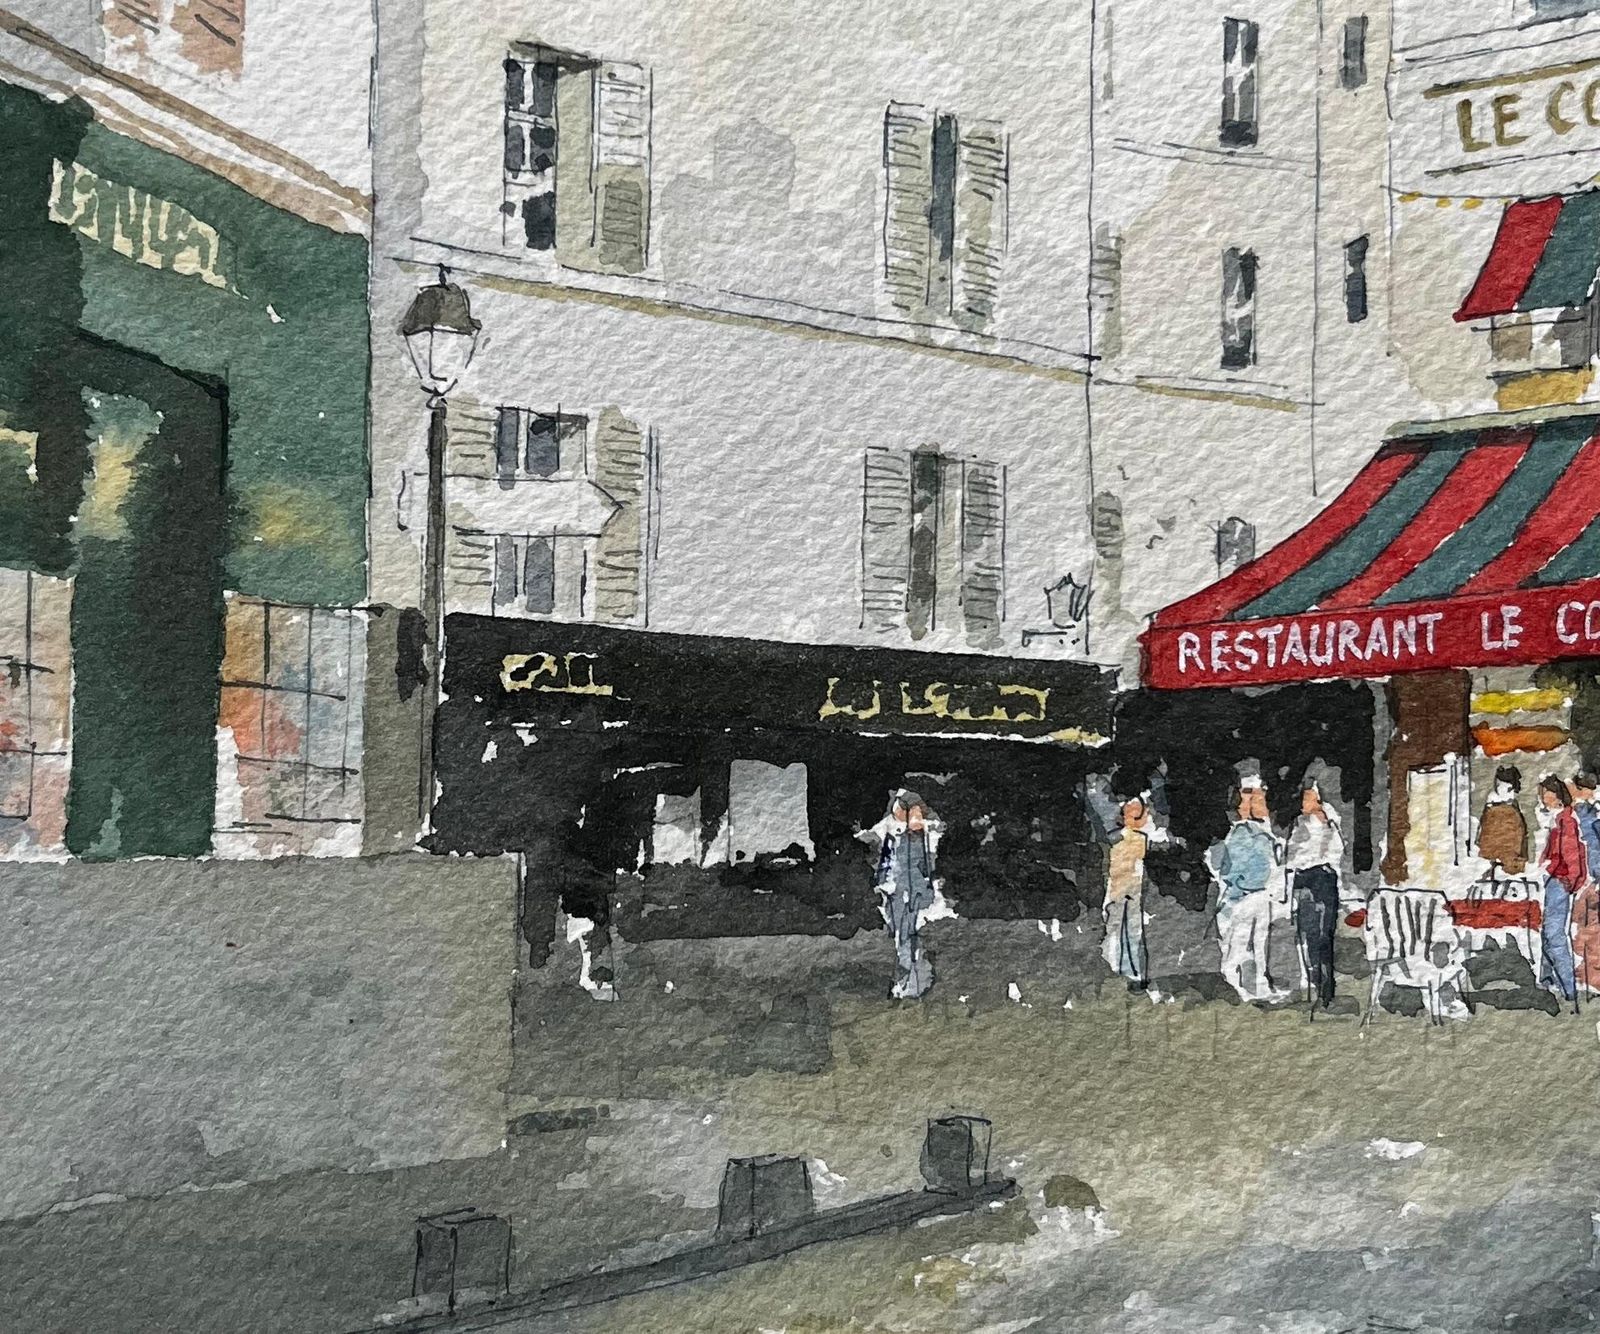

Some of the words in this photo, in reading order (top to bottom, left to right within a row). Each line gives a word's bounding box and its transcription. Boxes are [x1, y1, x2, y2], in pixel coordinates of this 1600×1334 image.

[1456, 94, 1532, 153] LE
[1178, 612, 1444, 673] RESTAURANT
[1481, 604, 1524, 651] LE
